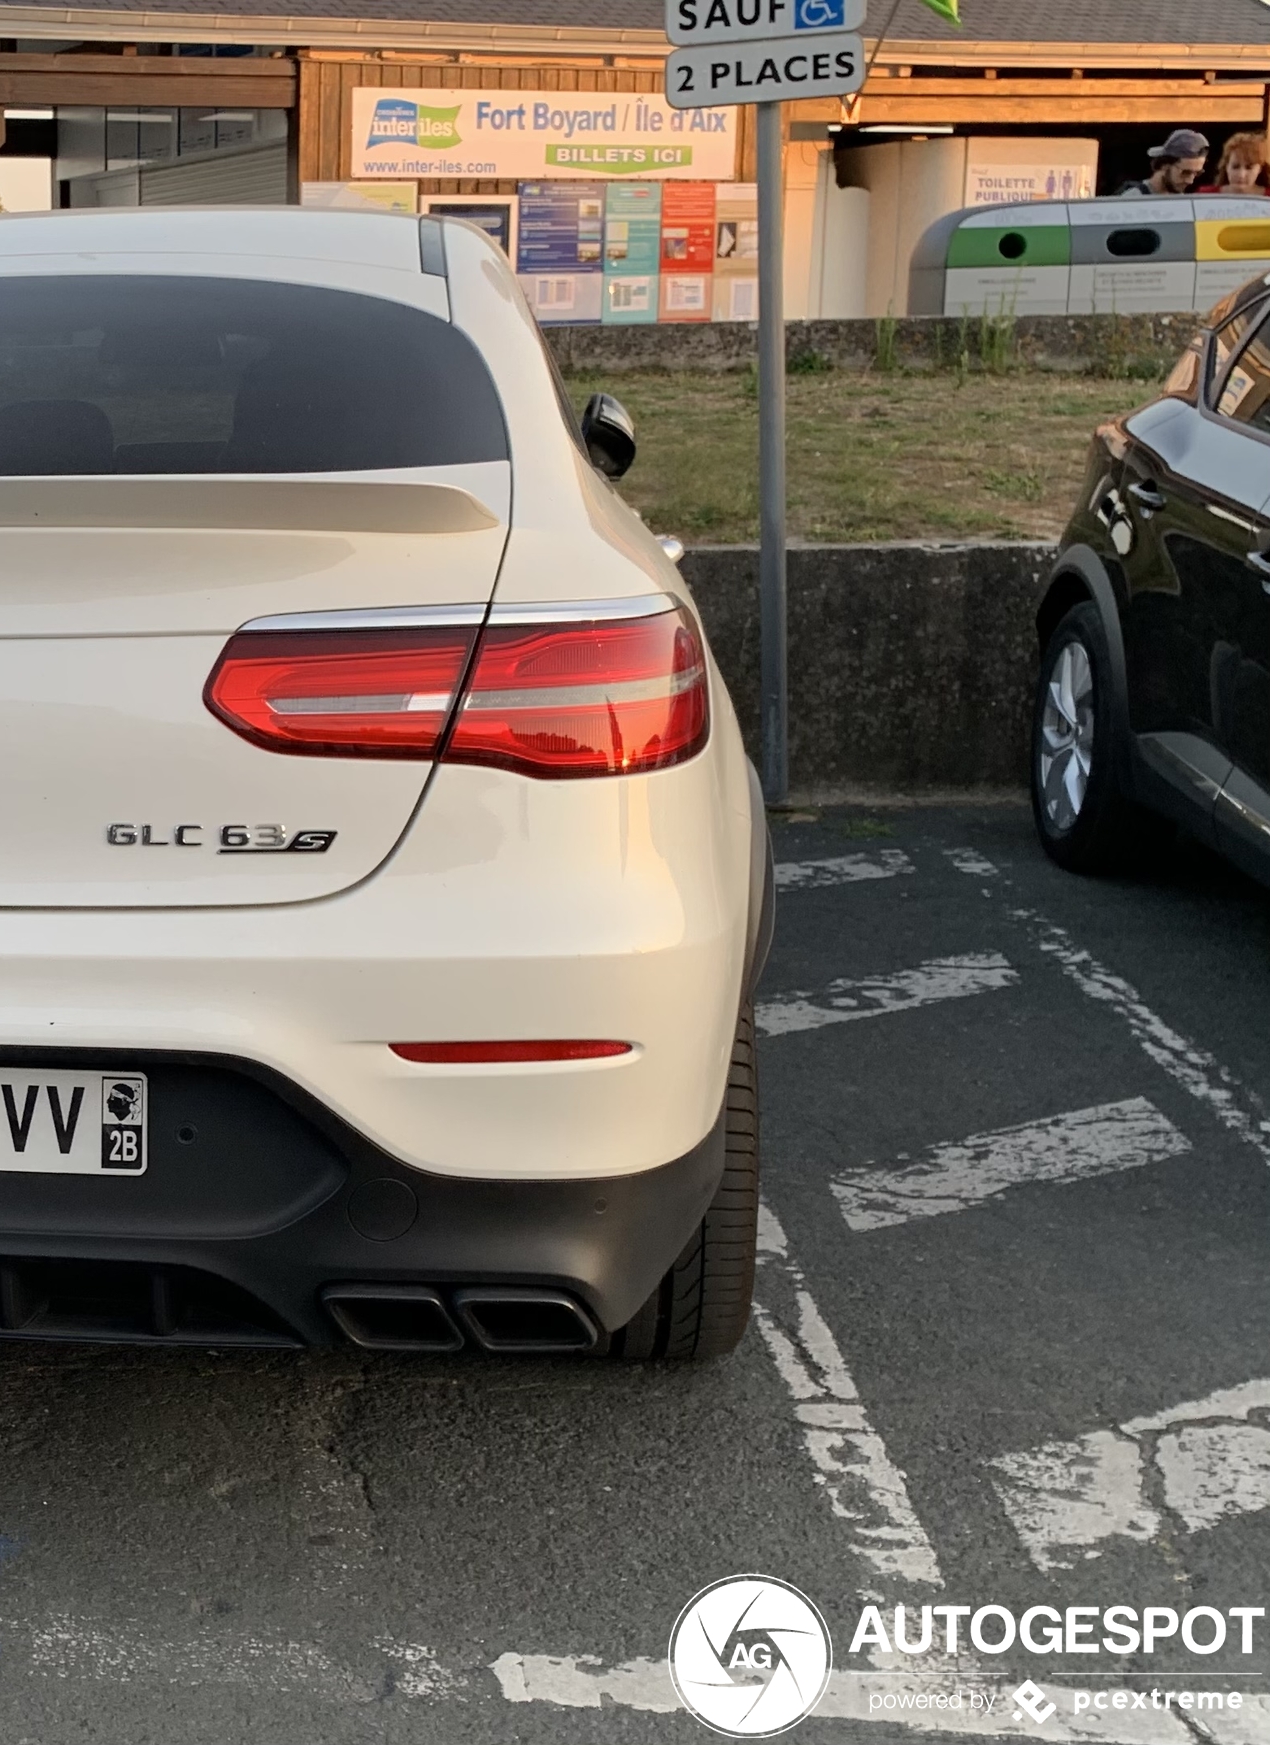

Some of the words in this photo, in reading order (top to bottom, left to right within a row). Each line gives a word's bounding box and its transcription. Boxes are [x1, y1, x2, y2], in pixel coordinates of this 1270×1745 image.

[679, 0, 785, 30] SAUF
[677, 66, 694, 92] 2
[711, 52, 855, 88] PLACES
[476, 102, 526, 130] Fort
[533, 103, 616, 138] Boyard
[622, 104, 630, 132] /
[635, 97, 663, 132] Île
[670, 107, 727, 132] d'Aix
[364, 159, 496, 173] www.inter-iles.com
[557, 148, 646, 162] BILLETS
[653, 149, 681, 163] ICI
[978, 178, 1035, 189] TOILETTE
[107, 823, 203, 846] GLC
[109, 1130, 138, 1161] 2B
